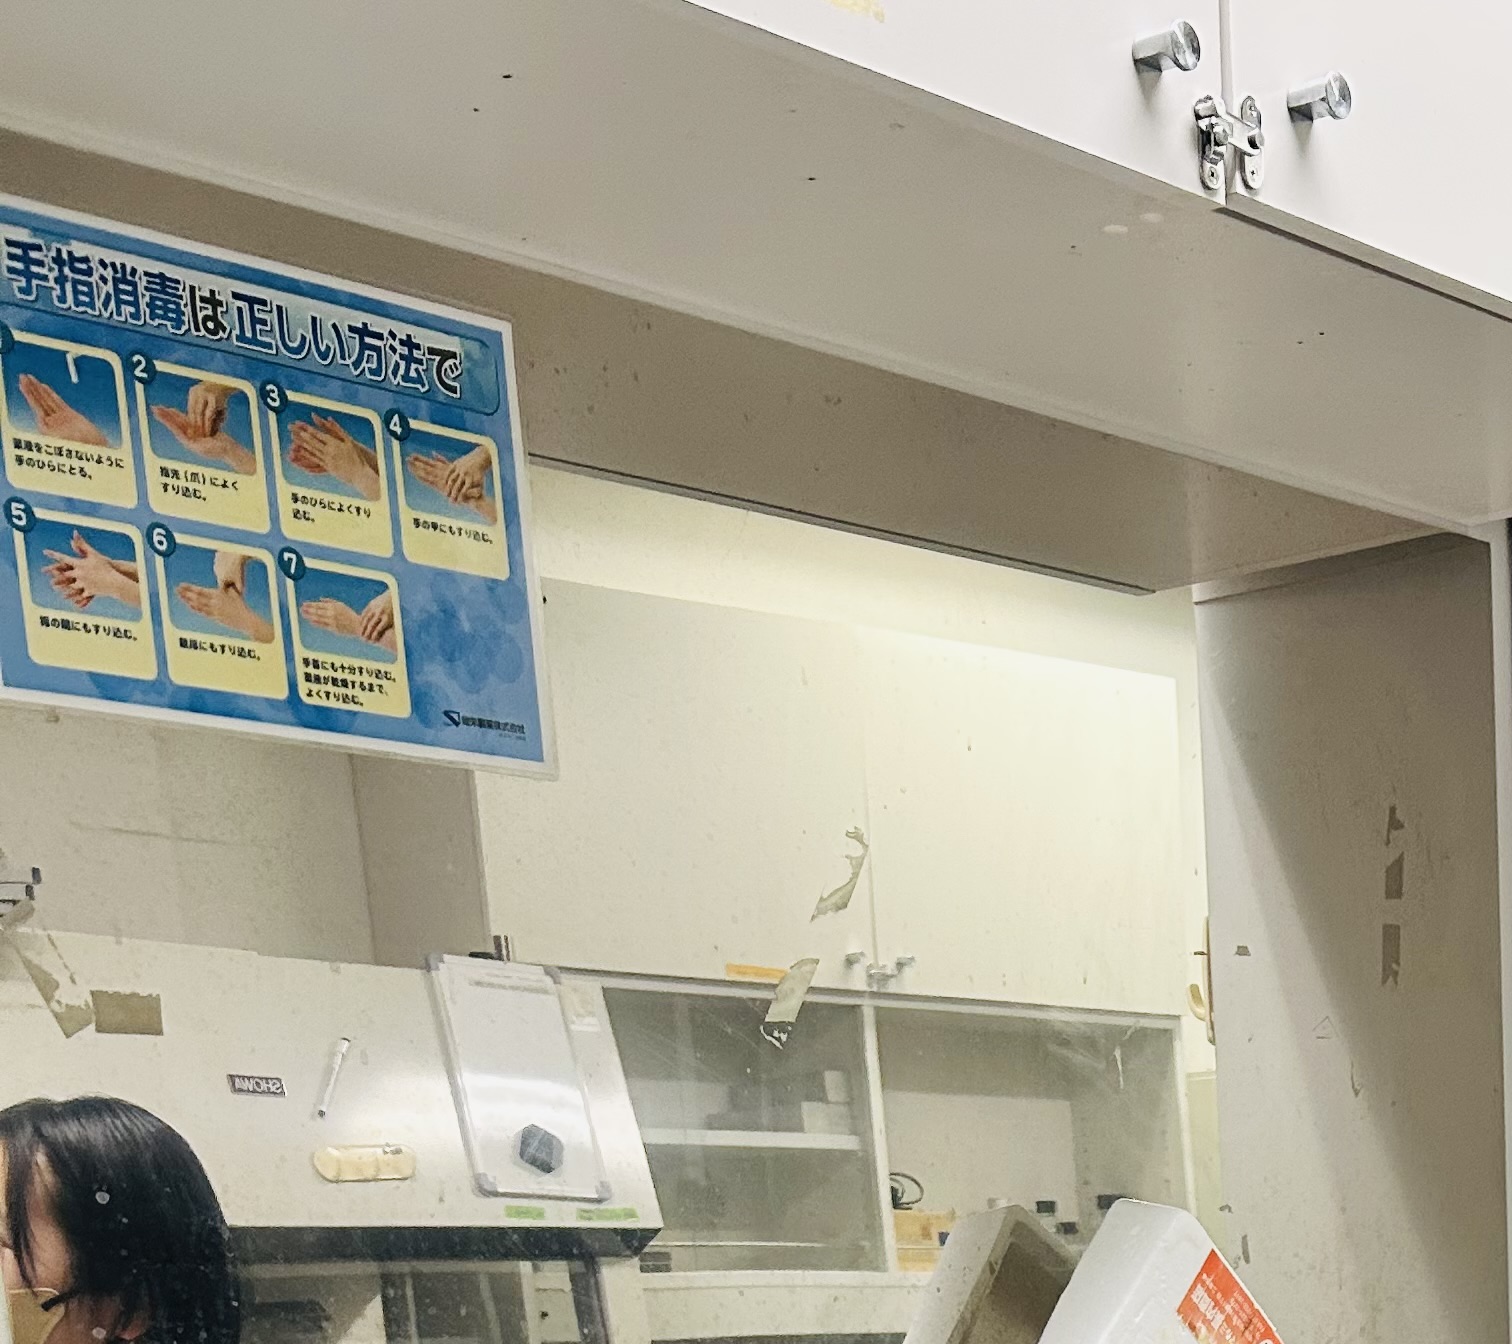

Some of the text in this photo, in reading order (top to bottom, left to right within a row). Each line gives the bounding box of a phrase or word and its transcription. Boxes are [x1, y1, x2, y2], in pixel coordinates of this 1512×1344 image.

[4, 238, 463, 398] 手指消毒は正しい方法で
[132, 354, 149, 379] 2
[265, 383, 281, 408] 3
[389, 413, 403, 436] 4
[10, 501, 27, 526] 5
[151, 527, 168, 551] 6
[283, 551, 298, 575] 7
